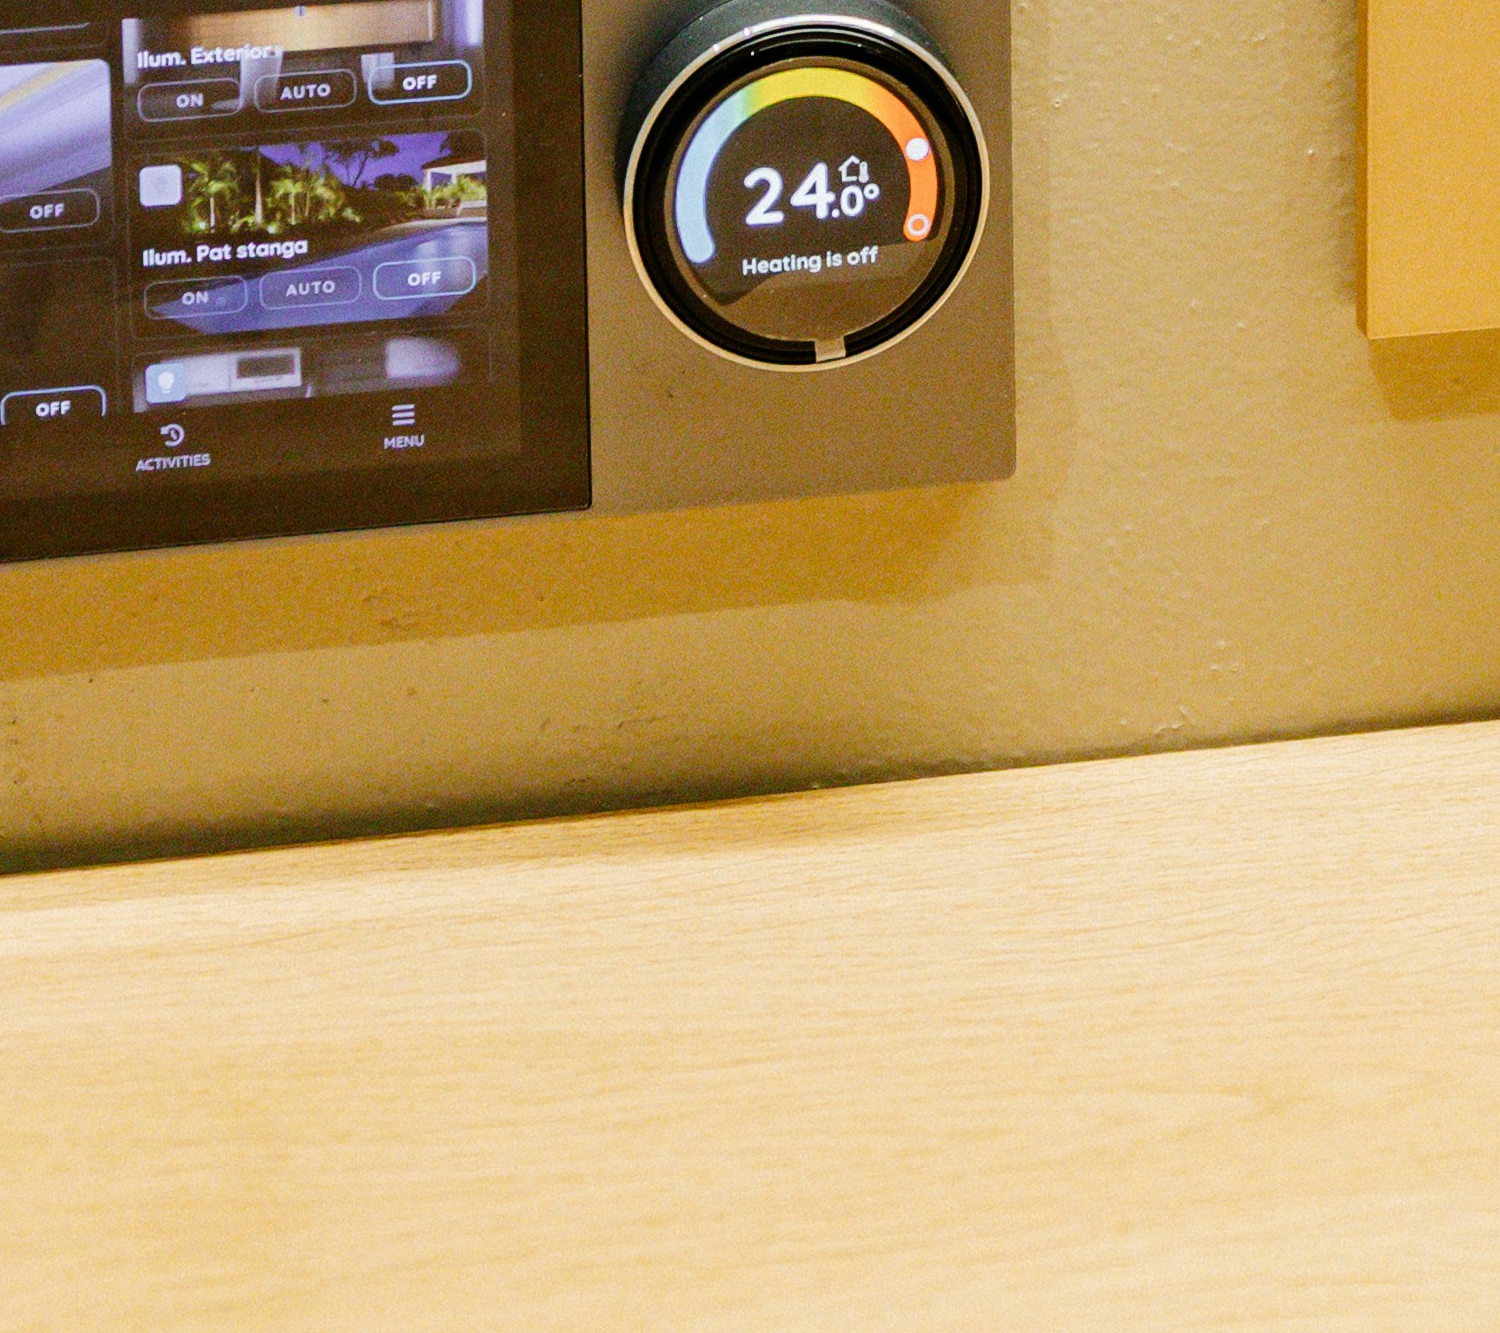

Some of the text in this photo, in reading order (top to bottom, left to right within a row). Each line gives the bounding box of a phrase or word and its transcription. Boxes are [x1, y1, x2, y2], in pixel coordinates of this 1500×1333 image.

[280, 83, 332, 101] AUTO
[402, 74, 438, 92] OFF
[176, 93, 204, 109] ON
[29, 202, 66, 220] OFF
[197, 244, 232, 263] Pat
[237, 238, 309, 260] stanga
[742, 245, 879, 276] Heating is off
[407, 270, 442, 287] OFF
[181, 289, 210, 306] ON
[286, 280, 336, 297] AUTO
[35, 400, 72, 418] OFF
[383, 434, 425, 450] MENU
[135, 452, 211, 472] ACTIVITIES
